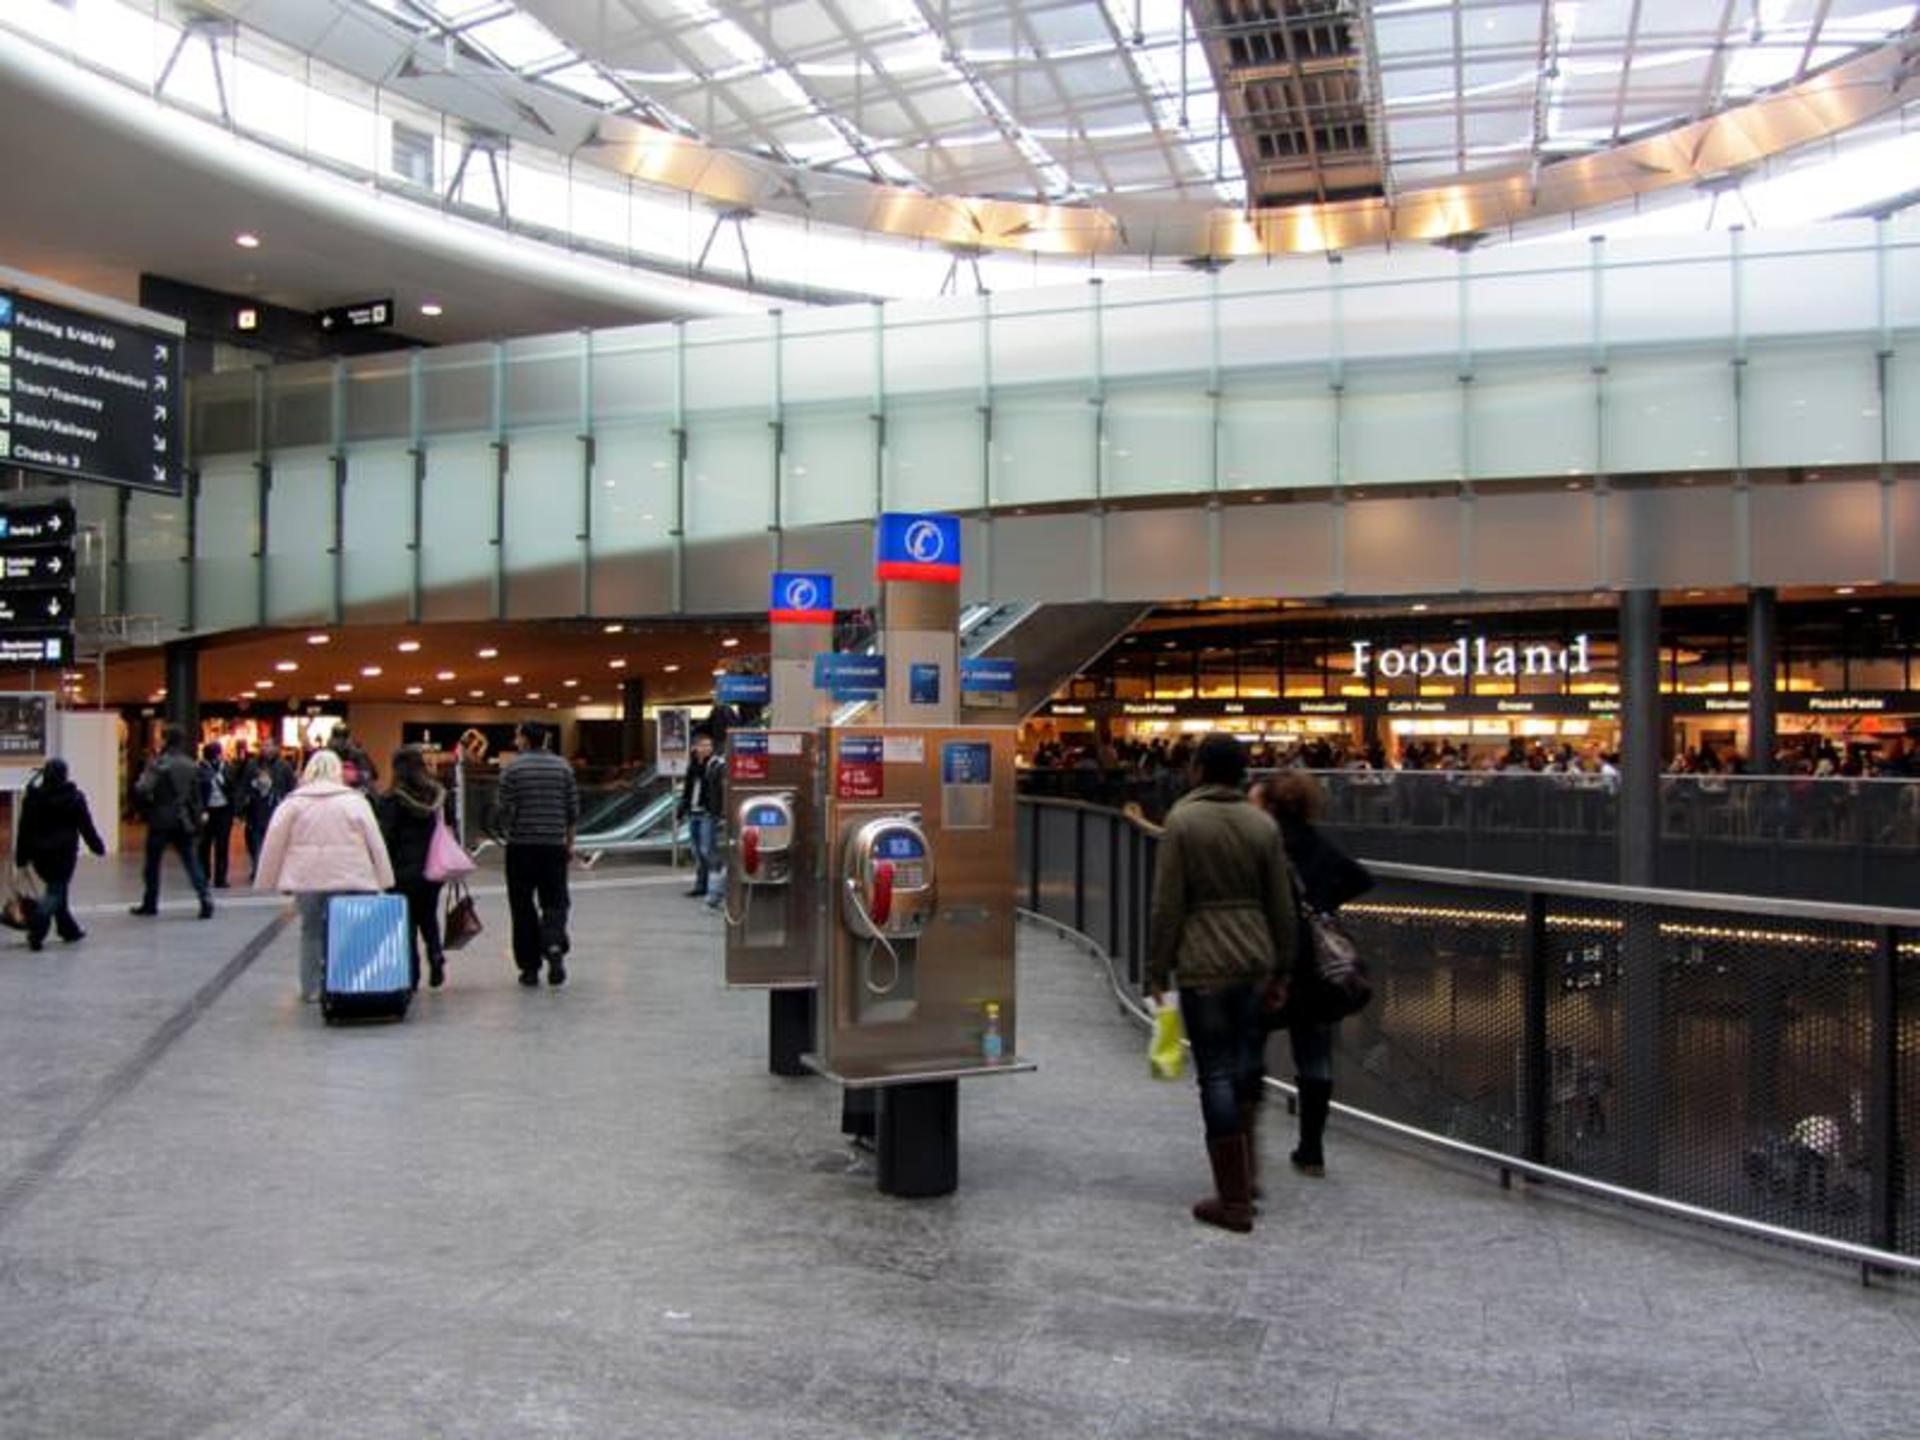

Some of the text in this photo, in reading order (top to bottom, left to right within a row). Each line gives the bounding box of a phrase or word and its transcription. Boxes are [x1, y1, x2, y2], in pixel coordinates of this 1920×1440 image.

[15, 311, 63, 339] Parking
[15, 377, 104, 411] Tram/Tramway
[15, 411, 98, 442] Bahn/Railway
[13, 443, 69, 466] Check-in
[1352, 634, 1591, 677] Foodland
